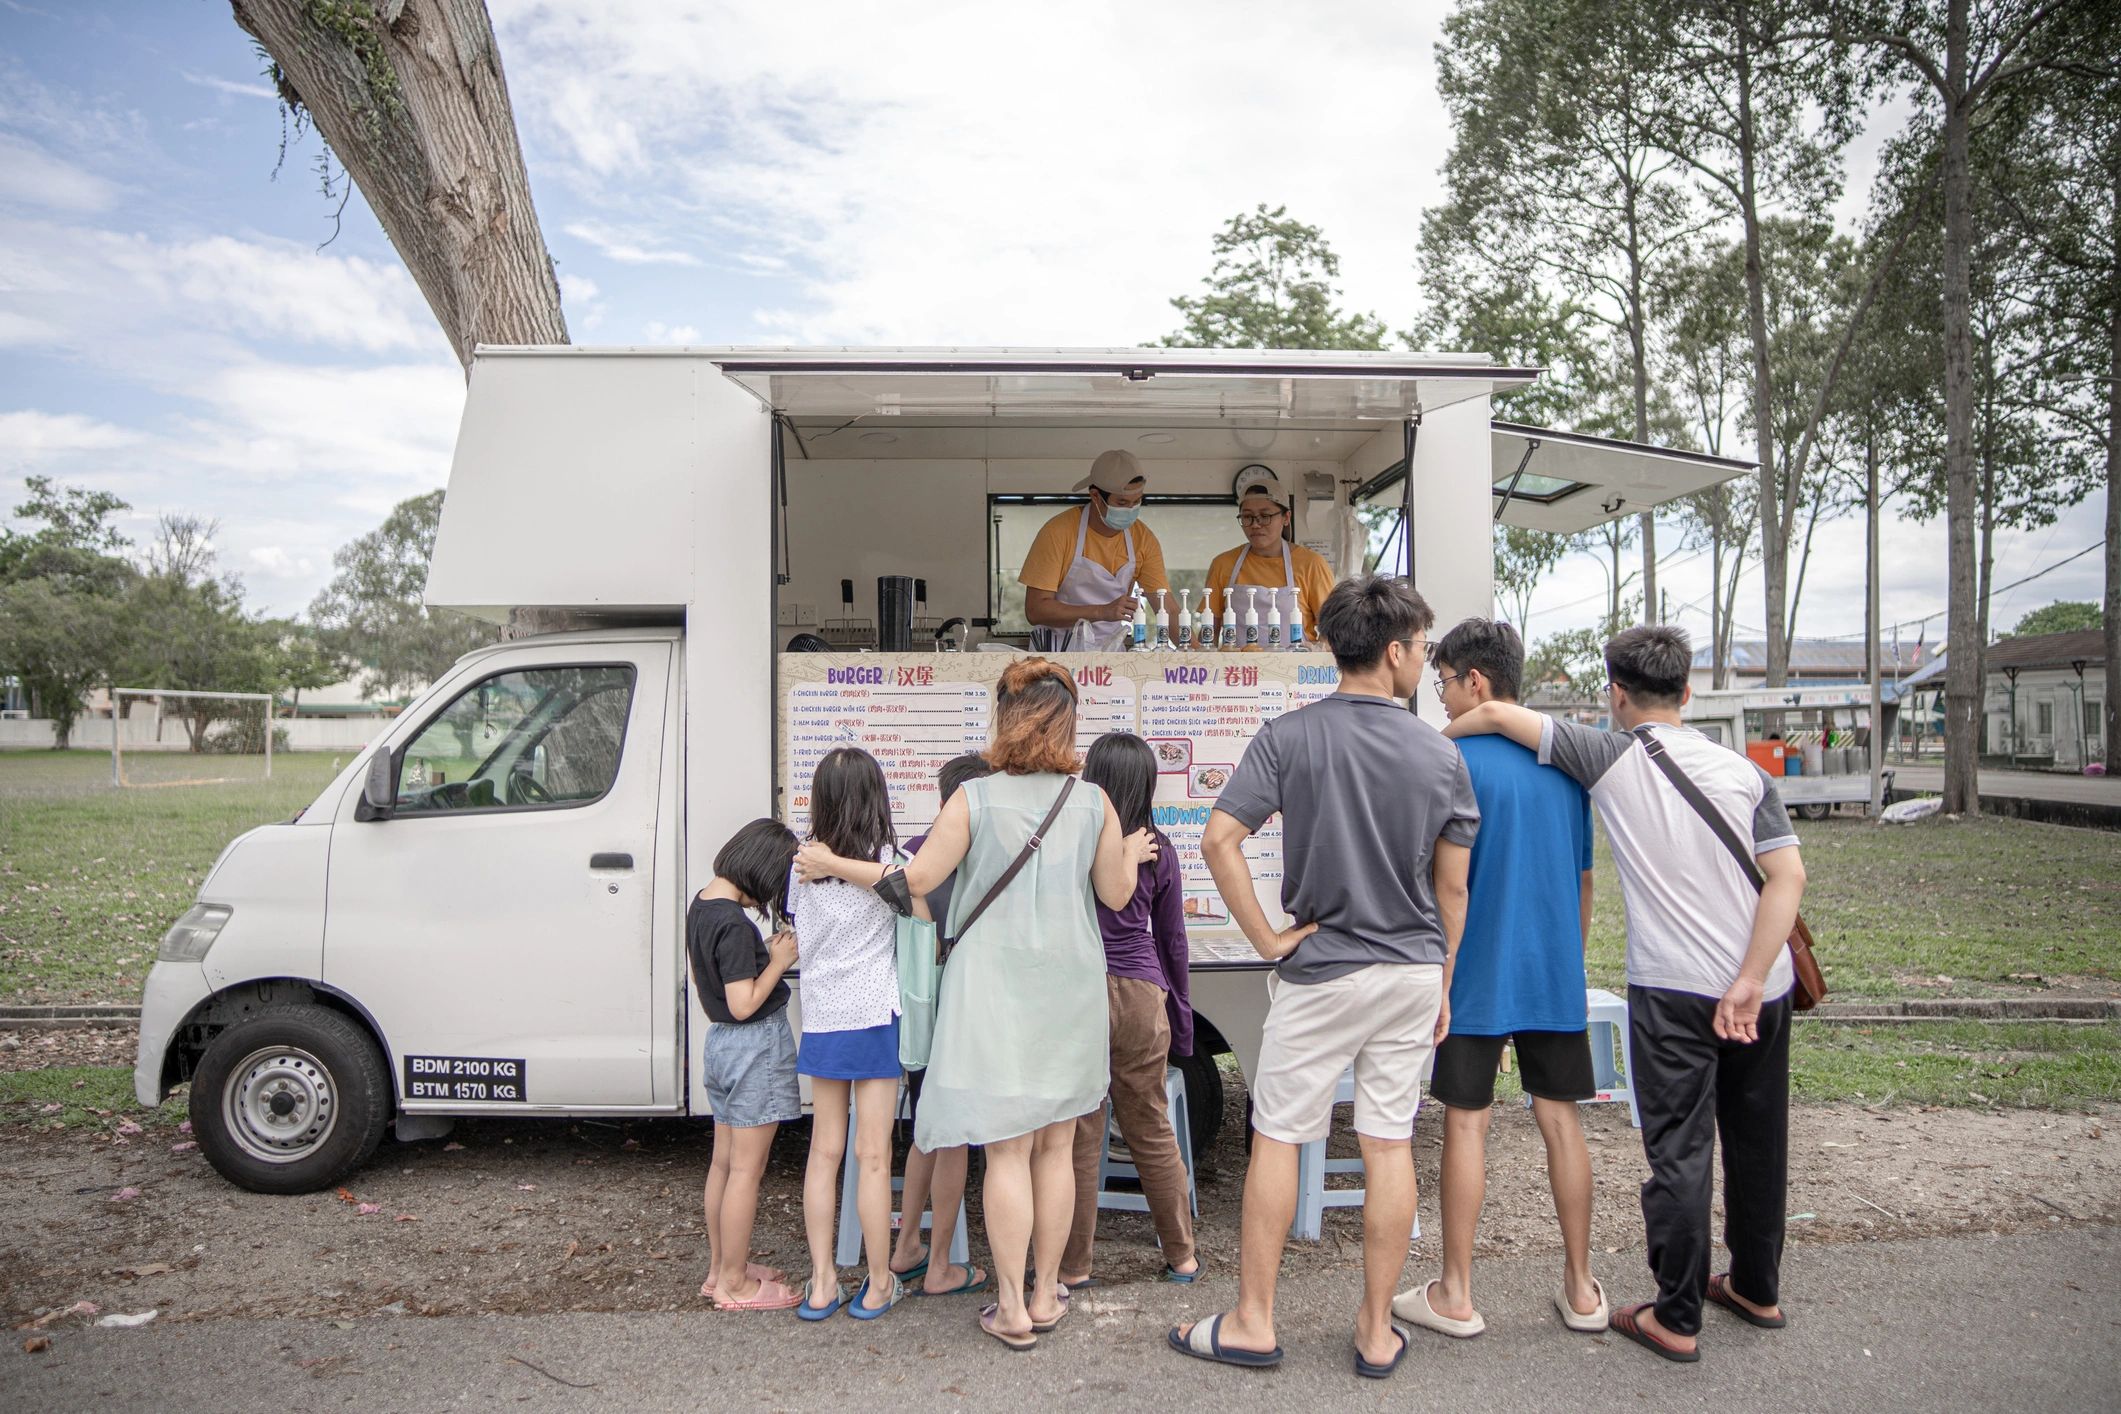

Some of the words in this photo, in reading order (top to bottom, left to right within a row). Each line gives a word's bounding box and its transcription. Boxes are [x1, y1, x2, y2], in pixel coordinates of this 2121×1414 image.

[827, 666, 883, 685] BURGER
[897, 665, 934, 687] 汉堡
[1077, 665, 1113, 687] 小吃
[1164, 665, 1208, 686] WRAP
[1223, 665, 1259, 687] 卷饼
[1297, 665, 1339, 685] DRINK
[1166, 718, 1188, 726] CHICKEN
[793, 796, 809, 807] ADD
[1151, 805, 1210, 826] ANDWIC
[412, 1058, 450, 1074] BDM
[453, 1060, 490, 1076] 2100
[493, 1062, 517, 1077] KG
[412, 1081, 449, 1097] BTM
[453, 1082, 487, 1099] 1570
[493, 1084, 517, 1099] KG
